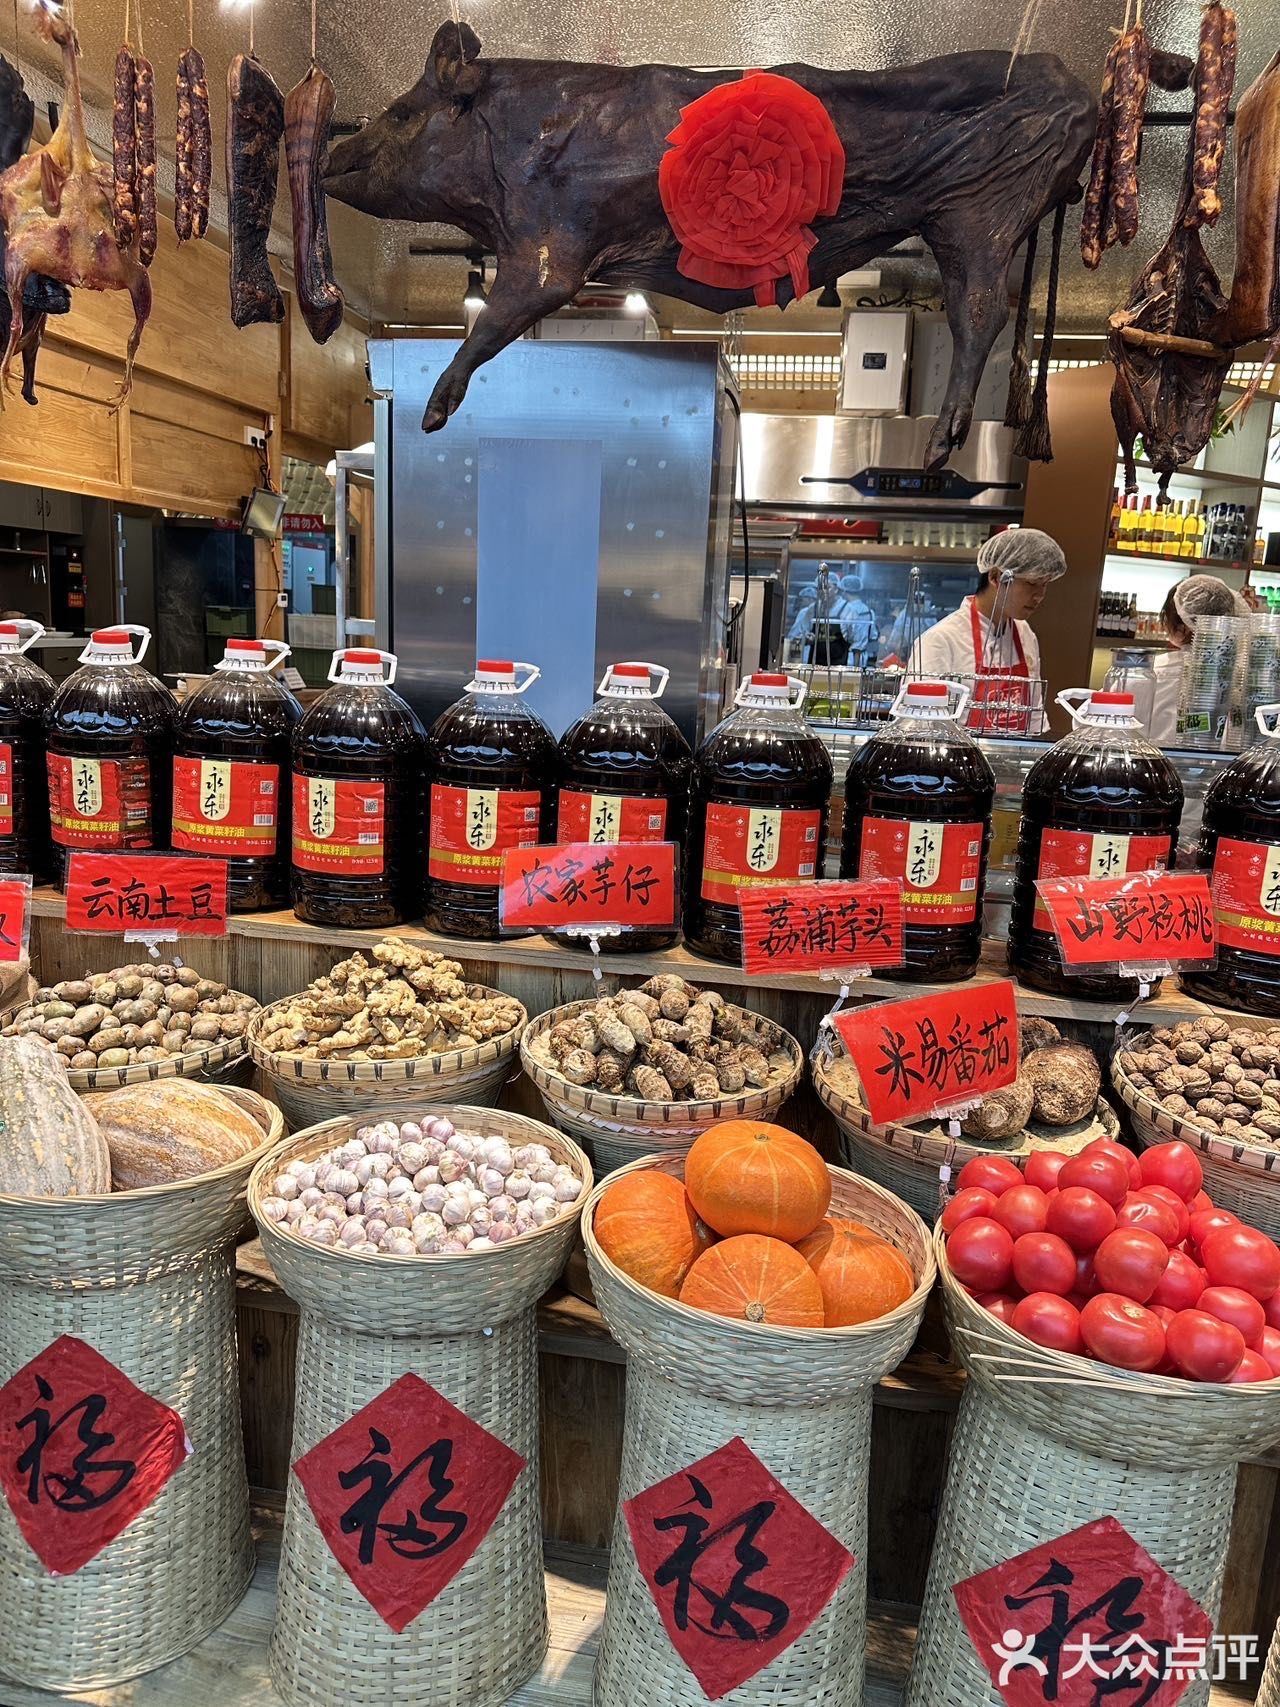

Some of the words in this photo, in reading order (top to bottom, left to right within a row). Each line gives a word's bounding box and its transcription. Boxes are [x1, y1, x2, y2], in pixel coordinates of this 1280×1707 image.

[519, 856, 660, 907] 农家芋仔
[1097, 841, 1120, 877] 永
[82, 876, 223, 921] 云南土豆
[758, 897, 893, 958] 荔浦芋头
[1066, 893, 1213, 944] 山野核桃
[1239, 915, 1280, 933] 原浆黄
[874, 1009, 1010, 1101] 米易番茄
[15, 1374, 137, 1512] 福
[338, 1426, 470, 1565] 福
[652, 1473, 790, 1641] 福
[1004, 1557, 1177, 1707] 福
